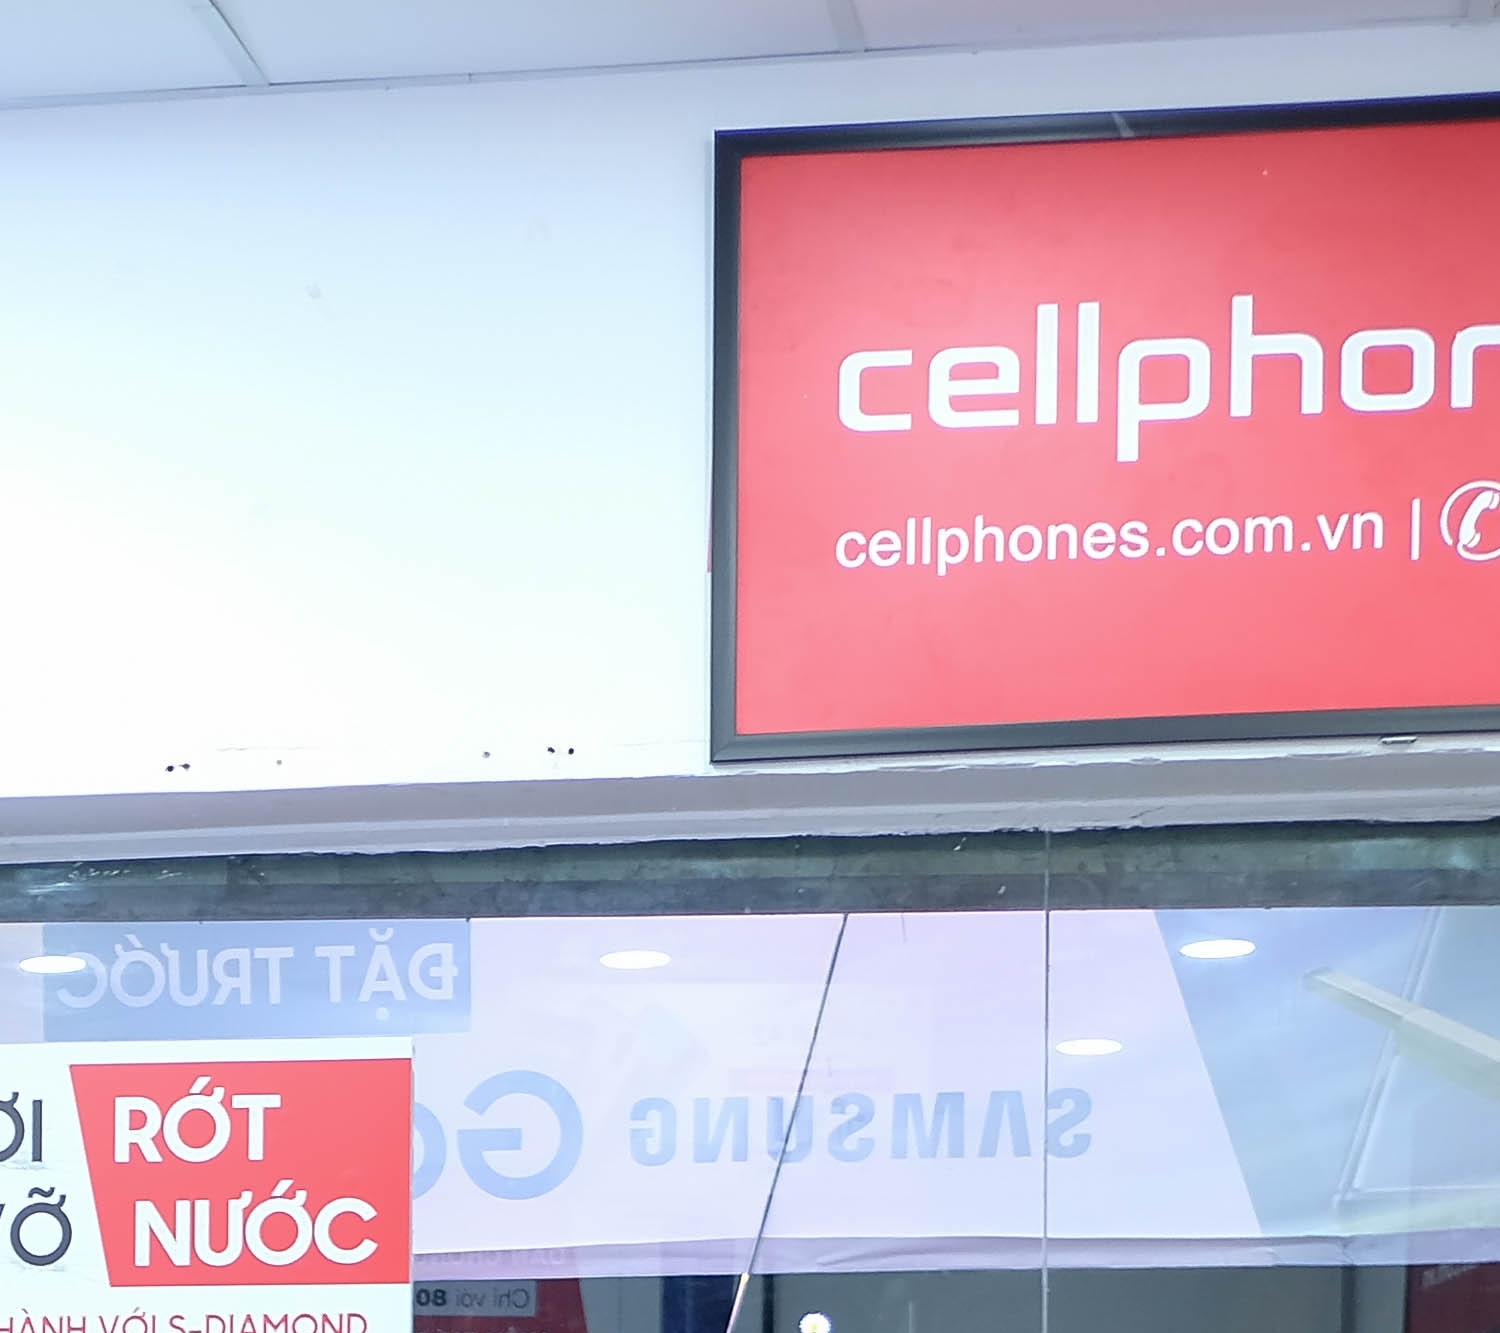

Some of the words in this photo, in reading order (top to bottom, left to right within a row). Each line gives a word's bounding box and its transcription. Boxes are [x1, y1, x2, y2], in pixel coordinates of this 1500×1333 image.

[834, 507, 1385, 577] cellphones.com.vn
[114, 1077, 281, 1164] RỚT
[134, 1180, 378, 1267] NƯỚC
